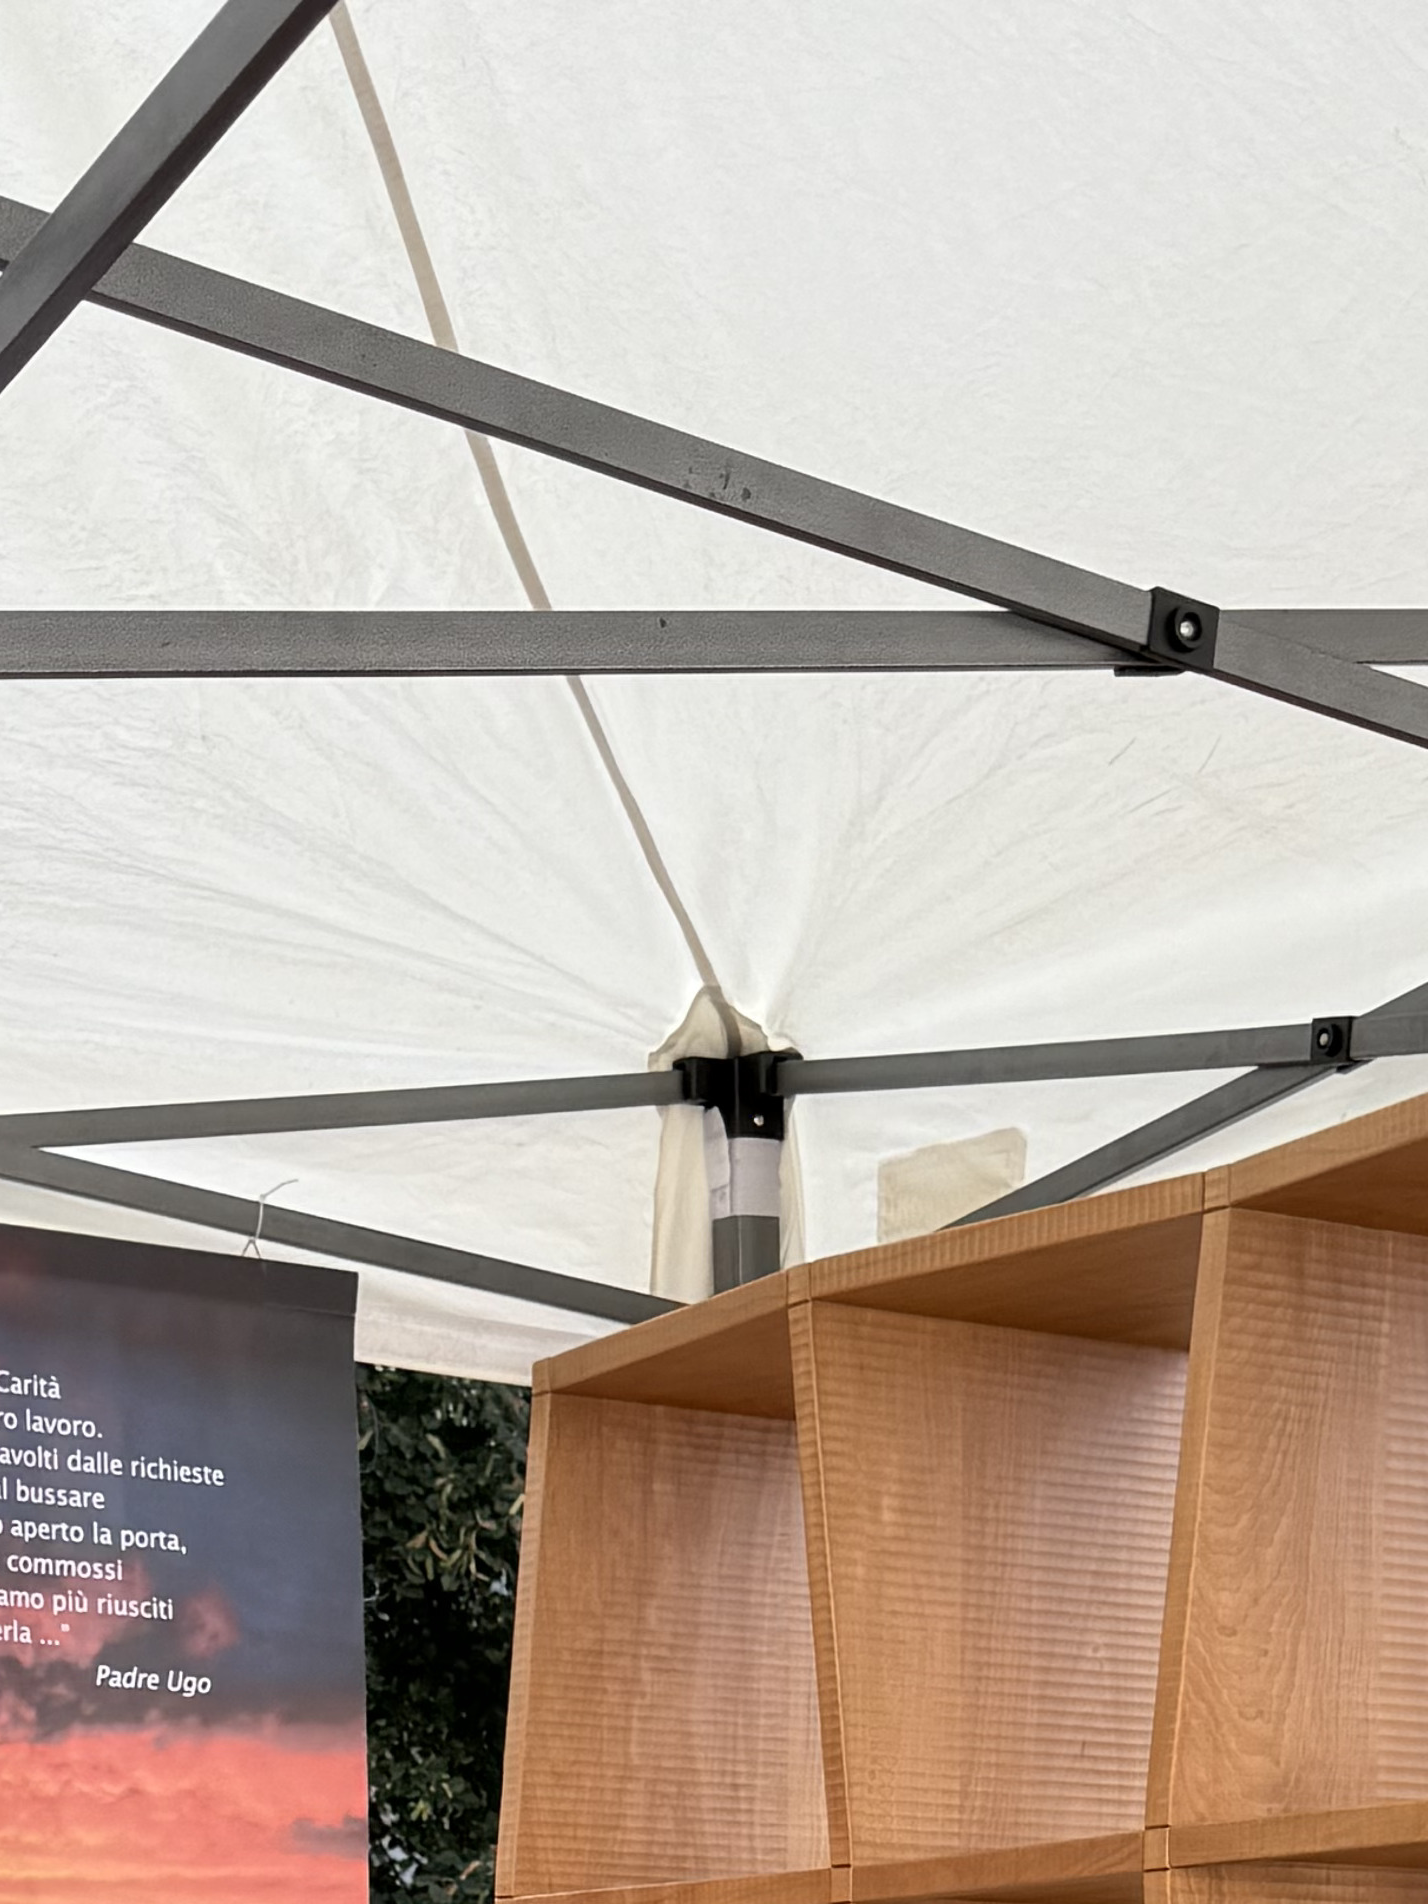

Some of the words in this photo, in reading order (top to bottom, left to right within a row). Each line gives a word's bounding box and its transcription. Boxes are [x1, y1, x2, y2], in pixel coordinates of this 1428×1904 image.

[25, 1407, 103, 1439] lavoro.
[66, 1448, 124, 1476] dalle
[130, 1455, 225, 1487] richieste
[15, 1477, 106, 1510] bussare
[9, 1519, 85, 1543] aperto
[92, 1520, 114, 1546] la
[120, 1529, 187, 1555] porta,
[6, 1554, 123, 1581] commossi
[51, 1589, 89, 1616] più
[96, 1592, 174, 1621] riusciti
[95, 1664, 160, 1691] Padre
[166, 1669, 212, 1698] Ugo
